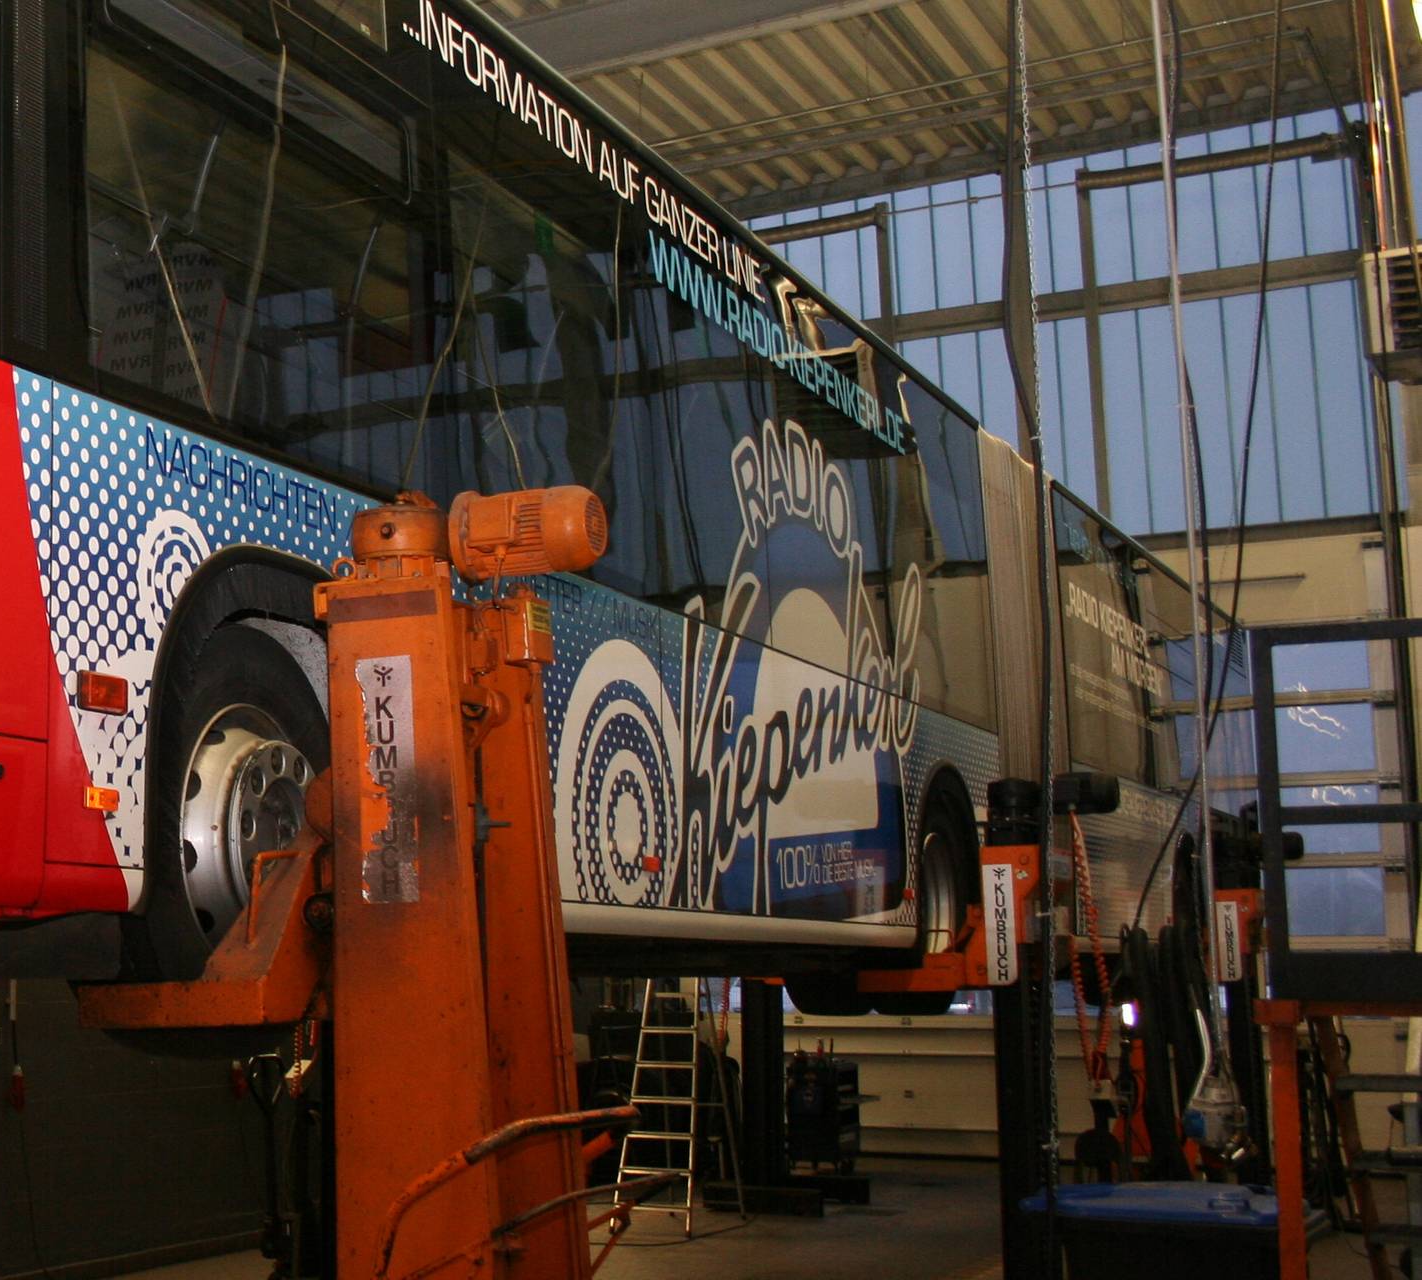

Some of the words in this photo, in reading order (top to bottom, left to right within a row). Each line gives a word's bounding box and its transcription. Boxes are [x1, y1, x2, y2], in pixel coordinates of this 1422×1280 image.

[598, 140, 639, 205] AUF
[644, 176, 721, 270] GANZER
[146, 426, 336, 536] NACHRICHTEN
[730, 418, 852, 558] RADIO
[375, 696, 400, 896] KUMBUCH
[776, 844, 821, 890] 100%
[994, 883, 1009, 981] KUMBRUCH
